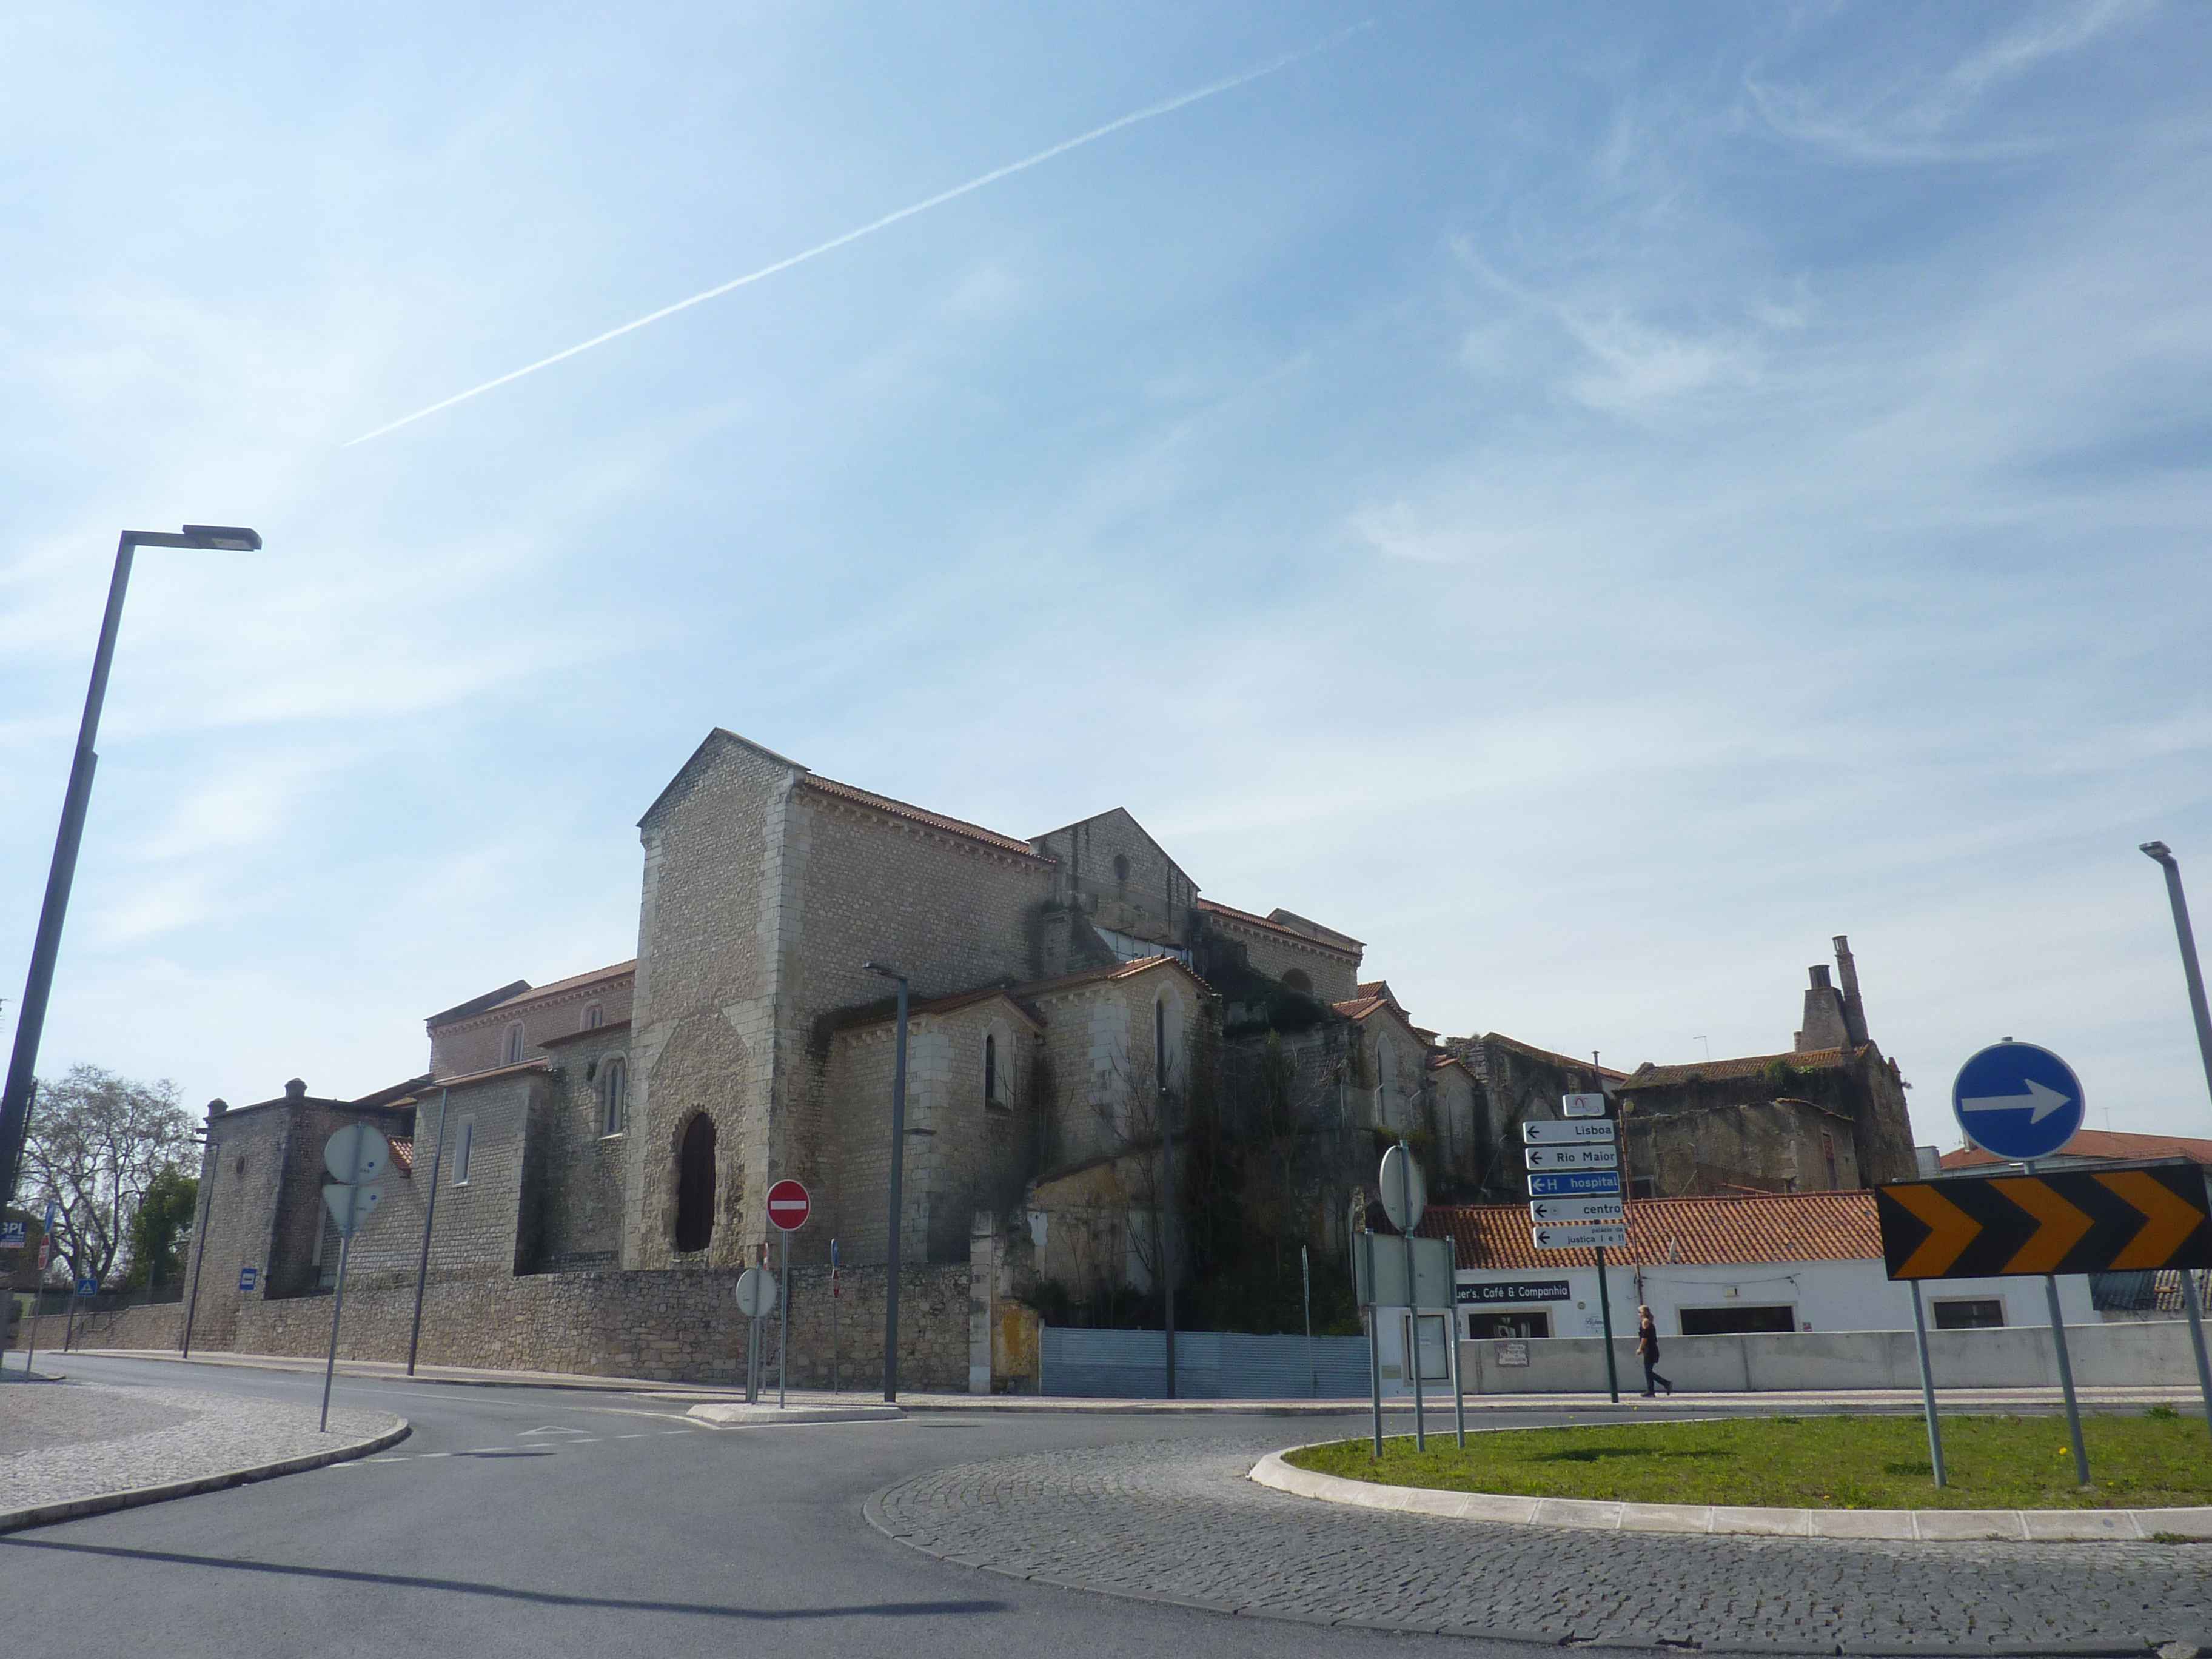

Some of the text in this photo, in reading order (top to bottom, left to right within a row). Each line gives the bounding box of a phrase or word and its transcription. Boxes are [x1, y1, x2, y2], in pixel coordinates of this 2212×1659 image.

[1575, 1126, 1612, 1136] Lisboa
[1557, 1151, 1615, 1162] Rio Maior
[1547, 1177, 1618, 1190] H hospital
[1584, 1205, 1621, 1215] centro
[1567, 1235, 1595, 1245] justiça
[1483, 1287, 1504, 1298] Café
[1508, 1287, 1515, 1297] &
[1518, 1285, 1567, 1298] Companhia
